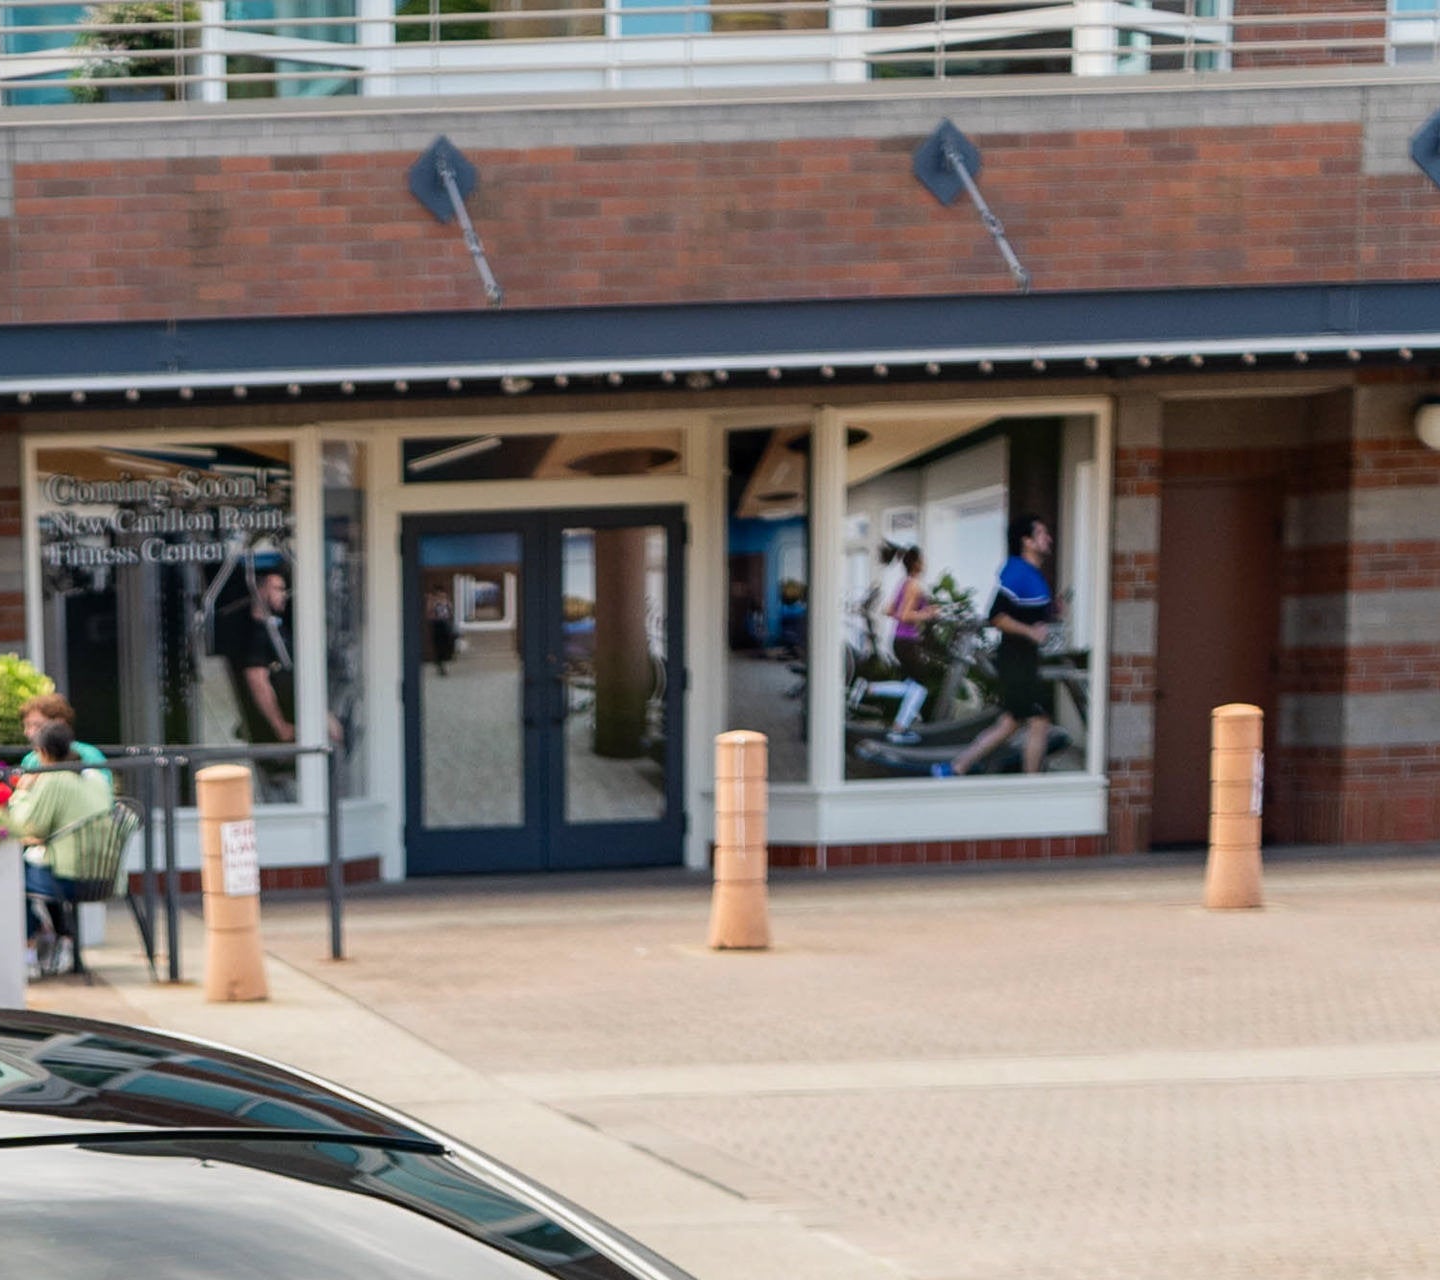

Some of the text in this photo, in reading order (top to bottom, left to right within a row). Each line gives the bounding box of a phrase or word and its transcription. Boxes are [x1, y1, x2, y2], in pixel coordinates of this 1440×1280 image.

[46, 469, 268, 507] Coming Soon!
[50, 511, 113, 536] New
[49, 541, 138, 566] Fitness
